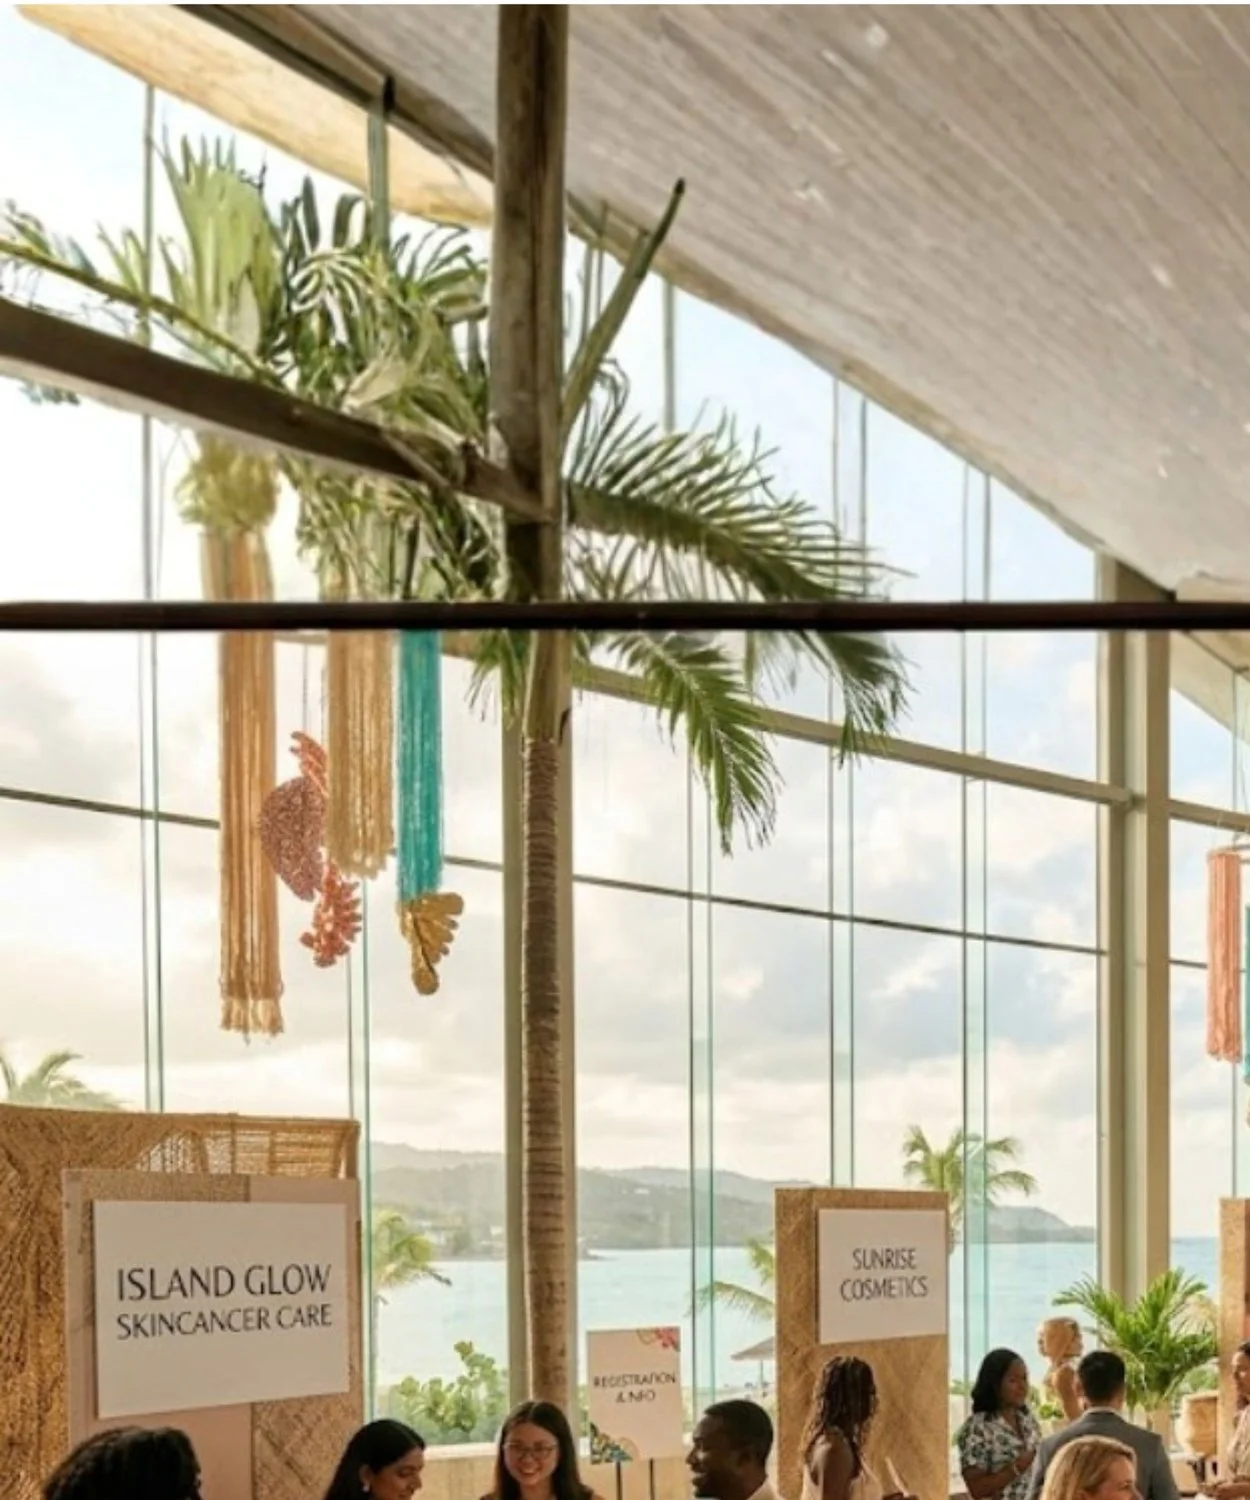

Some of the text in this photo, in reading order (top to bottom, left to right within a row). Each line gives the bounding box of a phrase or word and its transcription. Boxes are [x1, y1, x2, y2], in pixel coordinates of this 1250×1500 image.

[852, 1247, 917, 1271] SUNRISE
[116, 1263, 332, 1301] ISLAND GLOW
[840, 1275, 928, 1302] COSMETICS
[116, 1303, 334, 1341] SKINCANCER CARE
